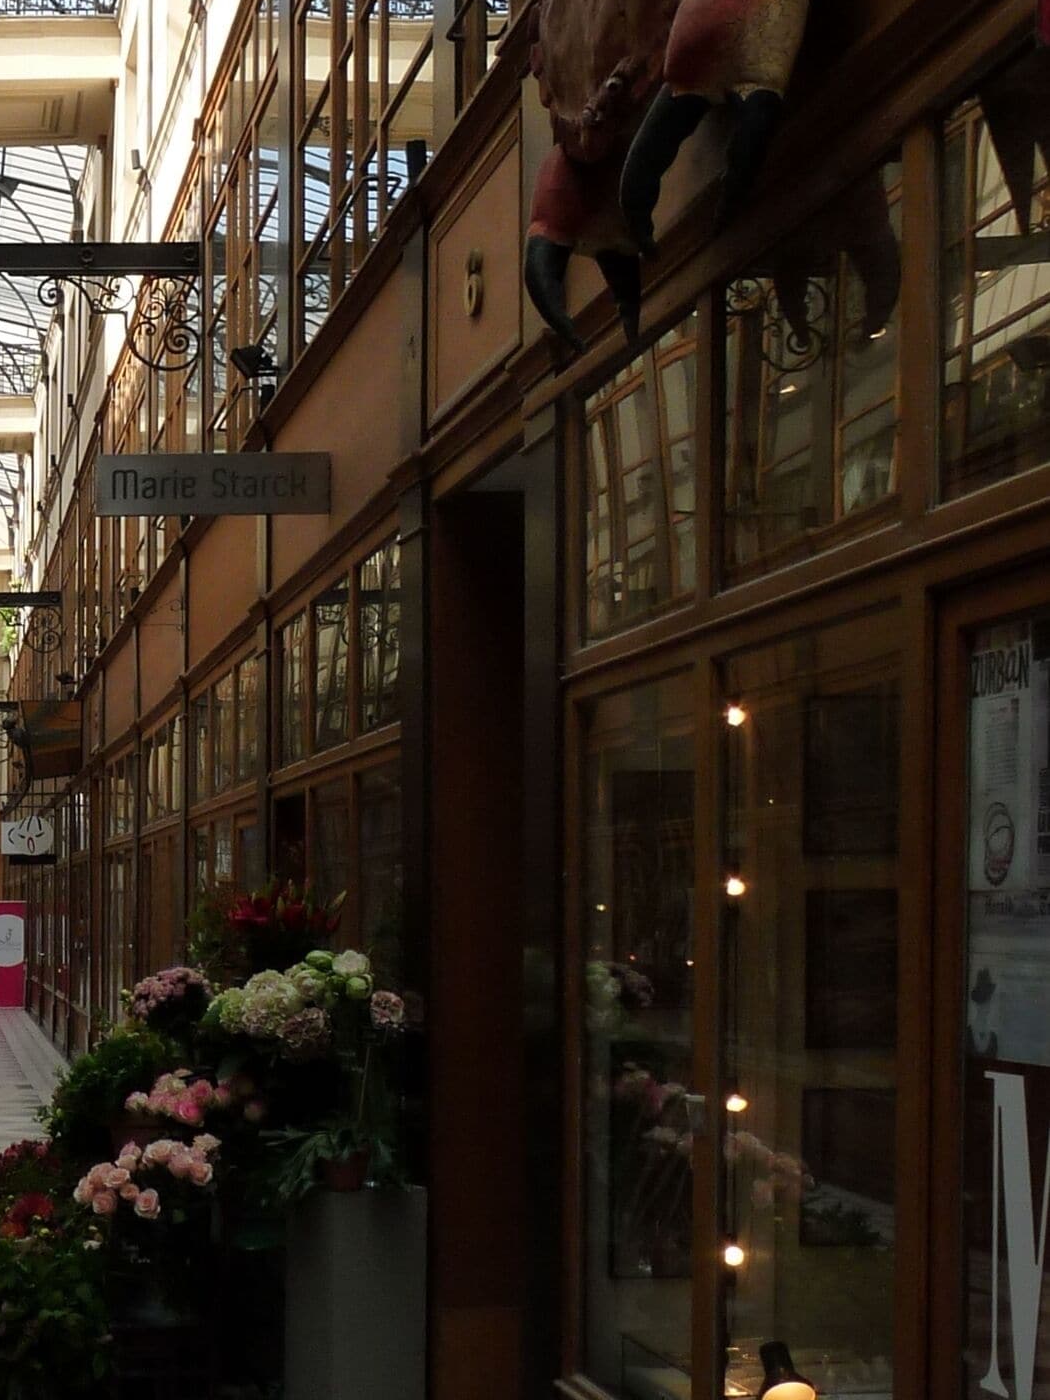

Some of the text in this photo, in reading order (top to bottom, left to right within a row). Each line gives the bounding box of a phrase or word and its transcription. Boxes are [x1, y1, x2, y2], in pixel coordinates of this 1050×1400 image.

[464, 248, 481, 317] 6
[111, 467, 307, 500] Marie Starck
